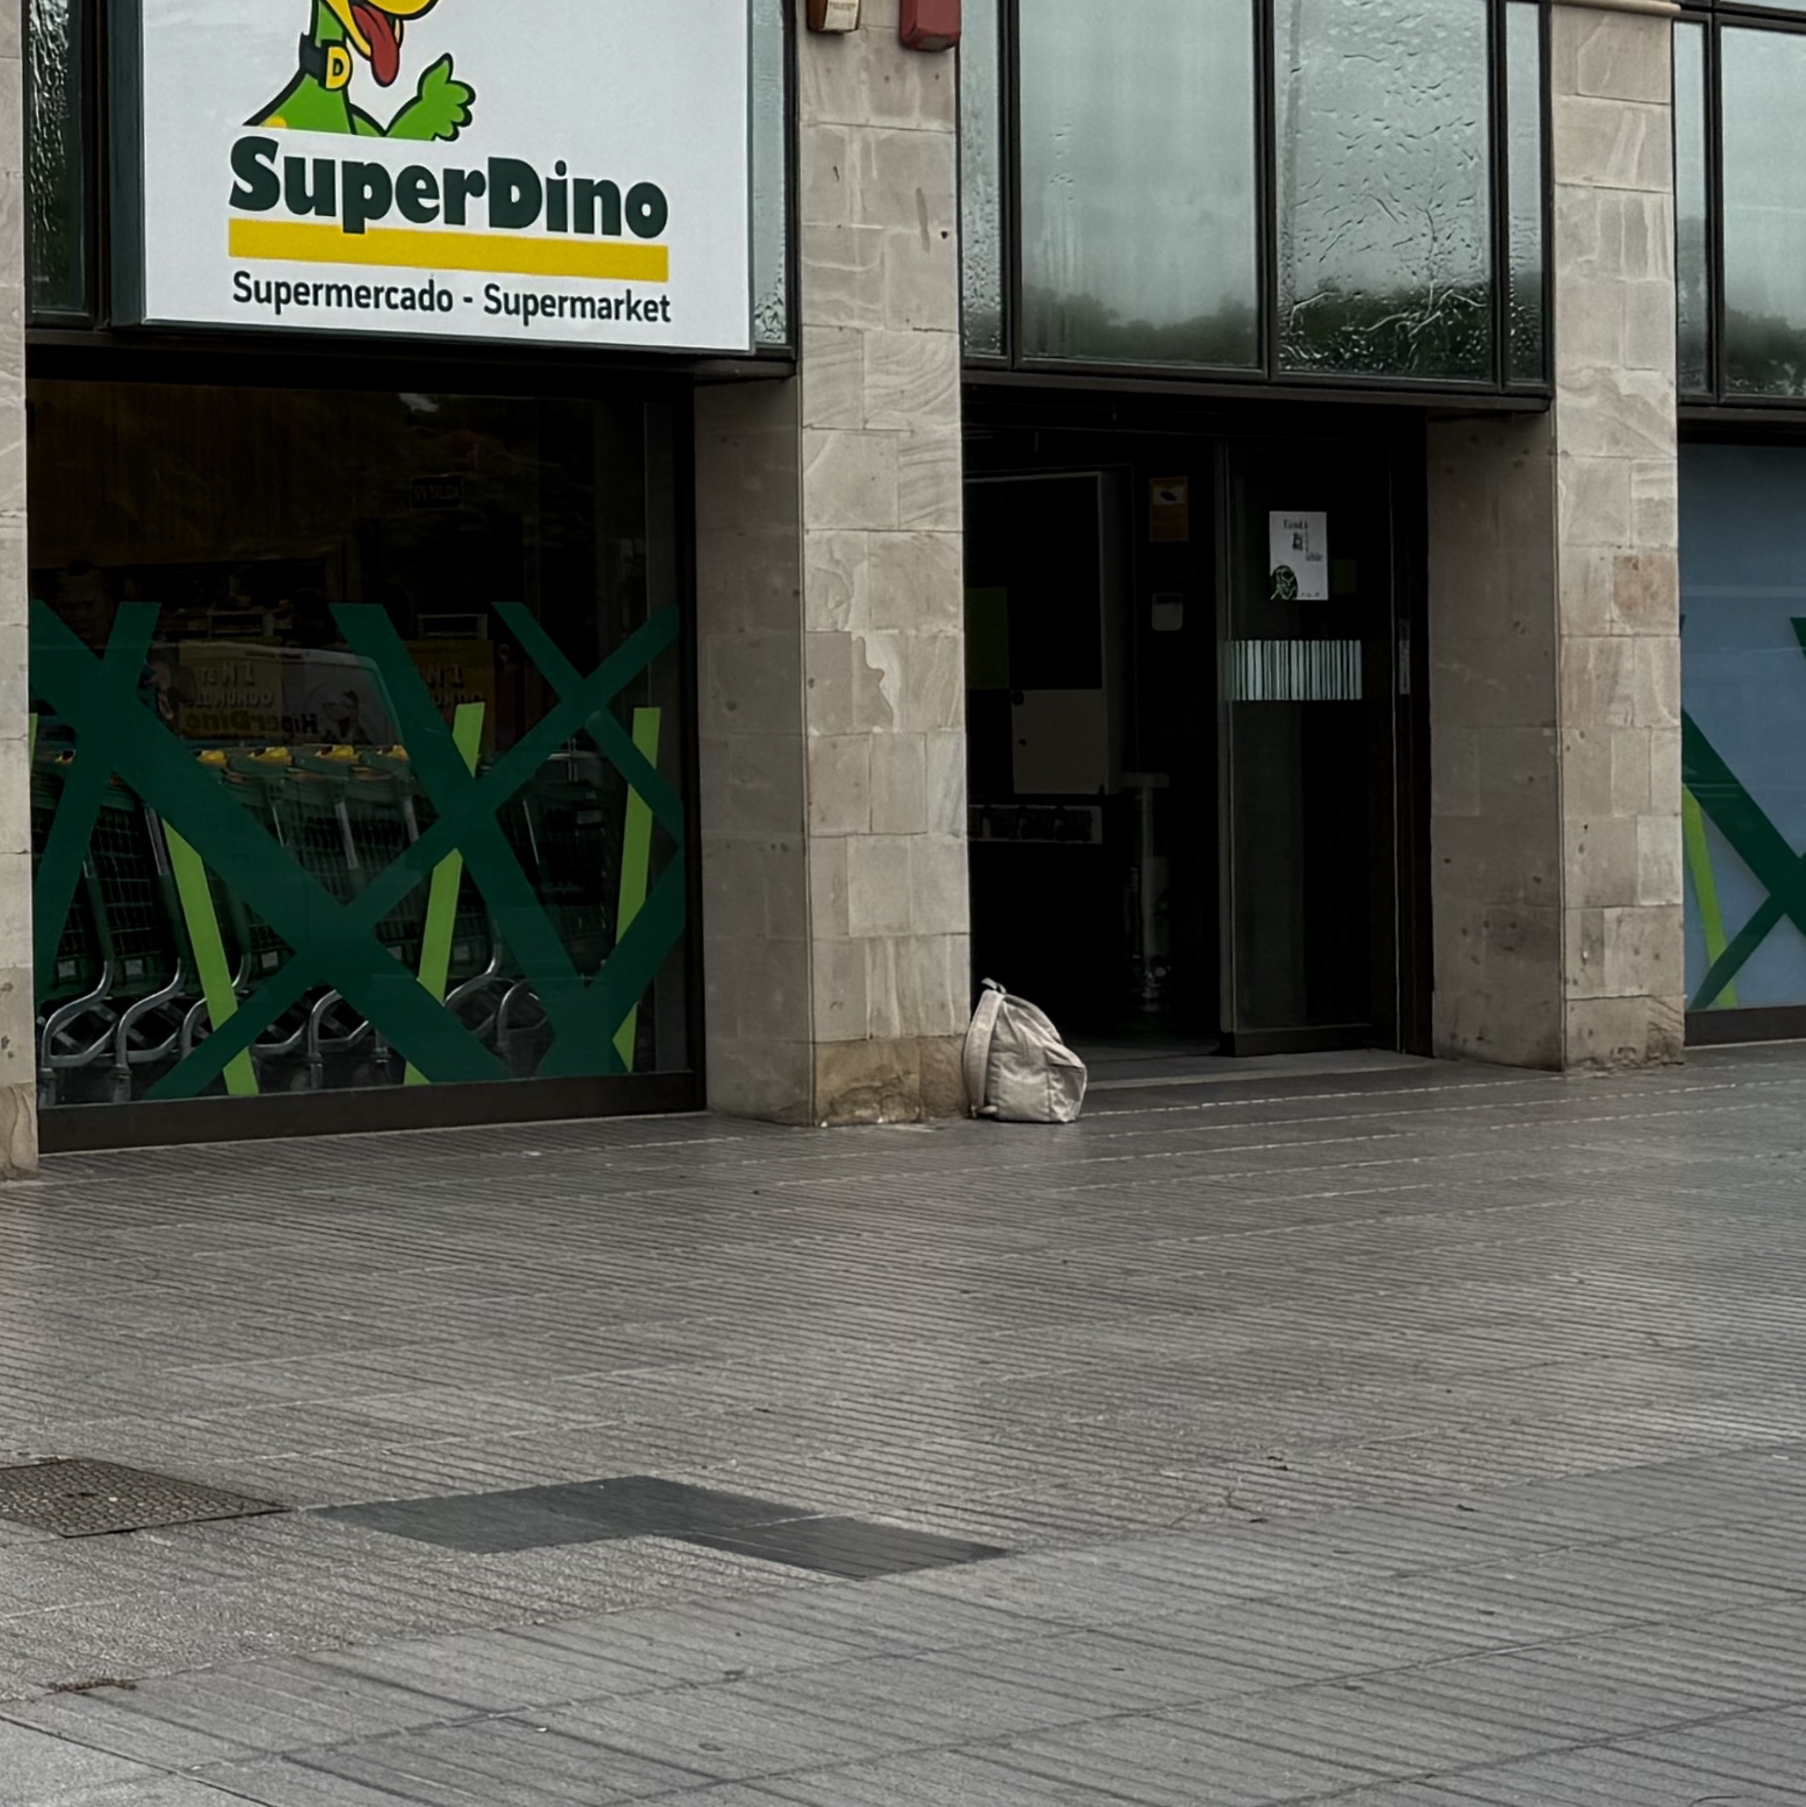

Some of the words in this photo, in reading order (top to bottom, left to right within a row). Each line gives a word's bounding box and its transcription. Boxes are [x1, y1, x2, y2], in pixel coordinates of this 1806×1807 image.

[229, 135, 669, 239] SuperDino
[232, 270, 454, 315] Supermercado
[483, 283, 671, 327] Supermarket
